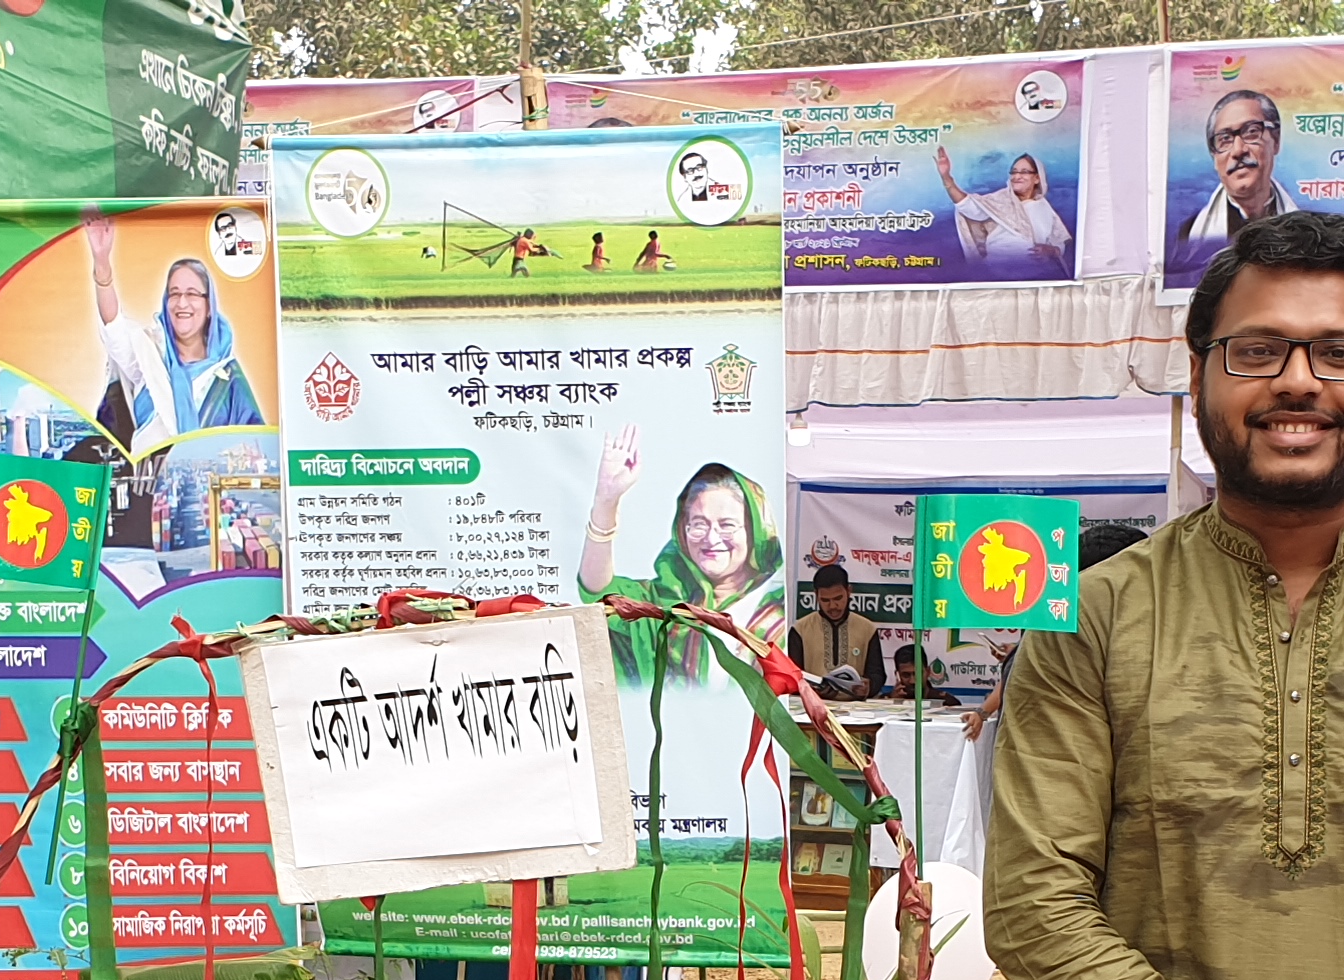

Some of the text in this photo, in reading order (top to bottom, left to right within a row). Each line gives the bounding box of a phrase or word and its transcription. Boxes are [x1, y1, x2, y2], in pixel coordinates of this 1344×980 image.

[806, 101, 895, 122] অনন্য অর্জন
[857, 129, 889, 147] দেশে
[843, 156, 901, 181] অনুষ্ঠান
[804, 184, 863, 212] প্রকাশনী
[369, 344, 695, 376] আমার বাড়ি আমার খামার প্রকল্প
[446, 378, 620, 408] পল্লী সঞ্চয় ব্যাংক
[299, 453, 470, 478] দারিদ্র্য বিমোচনে অবদান
[297, 492, 485, 509] গ্রাম উন্নয়ন সমিতি গঠন ৪০১টি
[298, 512, 332, 529] উপকৃত
[335, 513, 358, 526] দরিদ্র
[361, 514, 391, 525] জনগণ
[509, 510, 542, 524] পরিবার
[336, 533, 376, 543] জনগণের
[528, 529, 550, 542] টাকা
[300, 551, 329, 562] সরকার
[415, 550, 437, 561] প্রদান
[528, 546, 550, 560] টাকা
[301, 568, 330, 580] সরকার
[425, 567, 447, 578] প্রদান
[537, 564, 559, 578] টাকা
[538, 582, 559, 595] টাকা
[101, 702, 179, 731] কমিউনিটি
[306, 642, 580, 774] একটি আদর্শ খামার বাড়ি
[104, 761, 181, 783] সবার জন্য
[67, 814, 82, 834] ৬
[107, 807, 172, 834] ডিজিটাল
[108, 858, 177, 886] বিনিয়োগ
[112, 913, 166, 938] সামাজিক
[223, 905, 268, 941] কর্মসূচি
[415, 927, 459, 938] E-mail
[538, 945, 617, 960] 1938-879523
